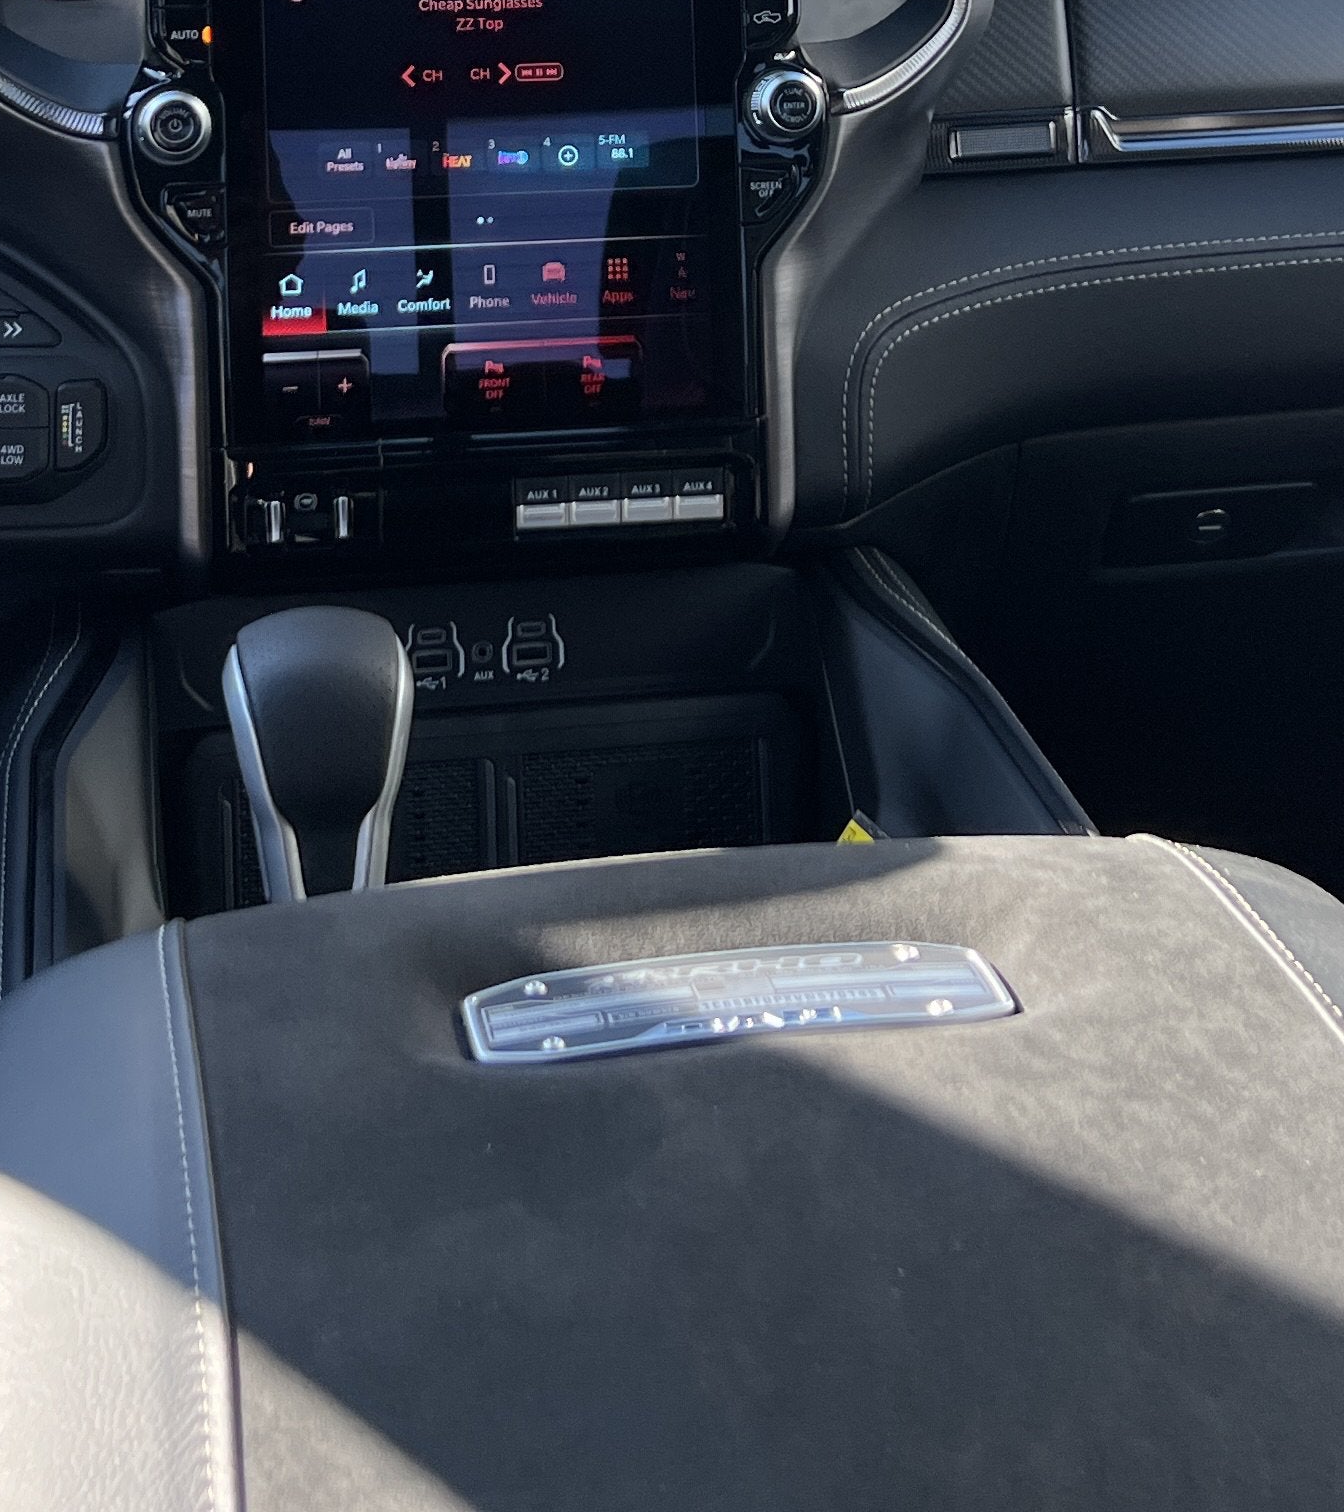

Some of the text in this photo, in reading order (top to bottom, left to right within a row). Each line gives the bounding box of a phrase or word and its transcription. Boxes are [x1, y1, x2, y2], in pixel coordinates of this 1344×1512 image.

[456, 18, 504, 31] ZZ Top
[171, 29, 199, 40] AUTO
[422, 69, 443, 82] CH
[470, 67, 490, 80] CH
[542, 136, 552, 147] 4
[337, 148, 352, 160] All
[326, 161, 365, 173] Presets
[442, 154, 473, 169] HEAT
[750, 181, 783, 191] SCREEN
[187, 208, 213, 218] MUTE
[289, 220, 354, 236] Edit Pages
[469, 294, 511, 309] Phone
[531, 291, 578, 306] Vehicle
[602, 289, 636, 305] Apps
[337, 300, 379, 316] Media
[397, 297, 451, 314] Comfort
[270, 305, 313, 320] Home
[0, 393, 26, 403] AXLE
[0, 444, 25, 454] 4WD
[0, 455, 24, 465] LOW
[579, 487, 601, 497] AUX
[631, 485, 653, 495] AUX
[682, 482, 705, 492] AUX
[527, 489, 549, 500] AUX
[474, 670, 495, 681] AUX
[541, 668, 550, 681] 2
